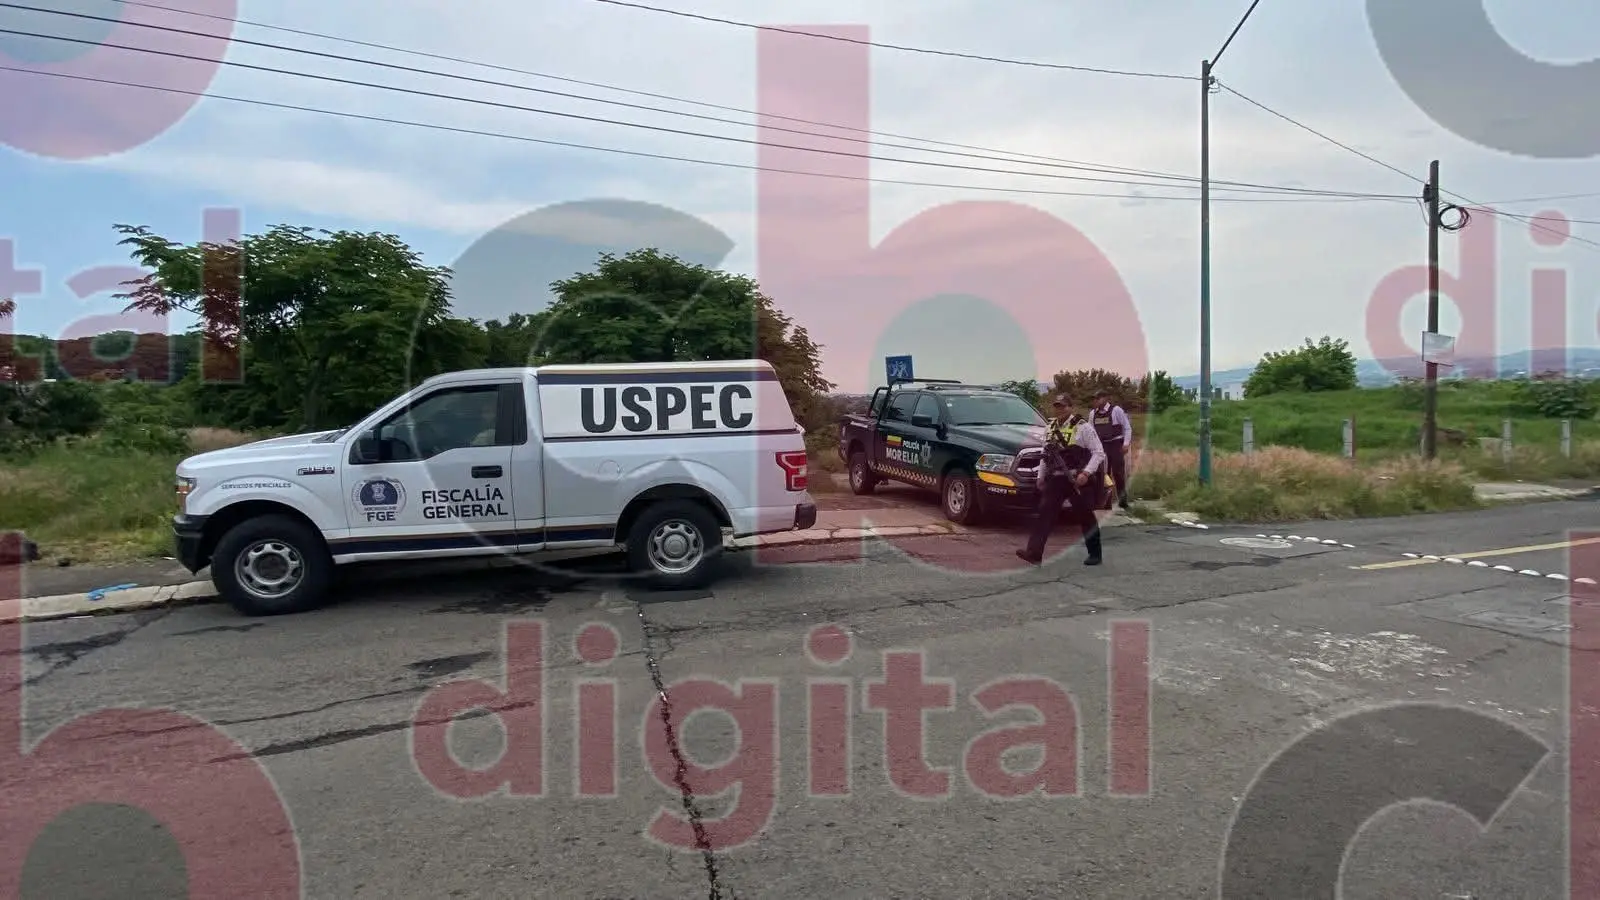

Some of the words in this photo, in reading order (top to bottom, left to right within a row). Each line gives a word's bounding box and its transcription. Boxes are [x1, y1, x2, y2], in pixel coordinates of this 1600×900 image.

[580, 384, 753, 433] USPEC
[886, 447, 919, 465] MORELIA
[422, 484, 504, 504] FISCALÍA
[366, 511, 396, 522] FGE
[423, 504, 508, 519] GENERAL
